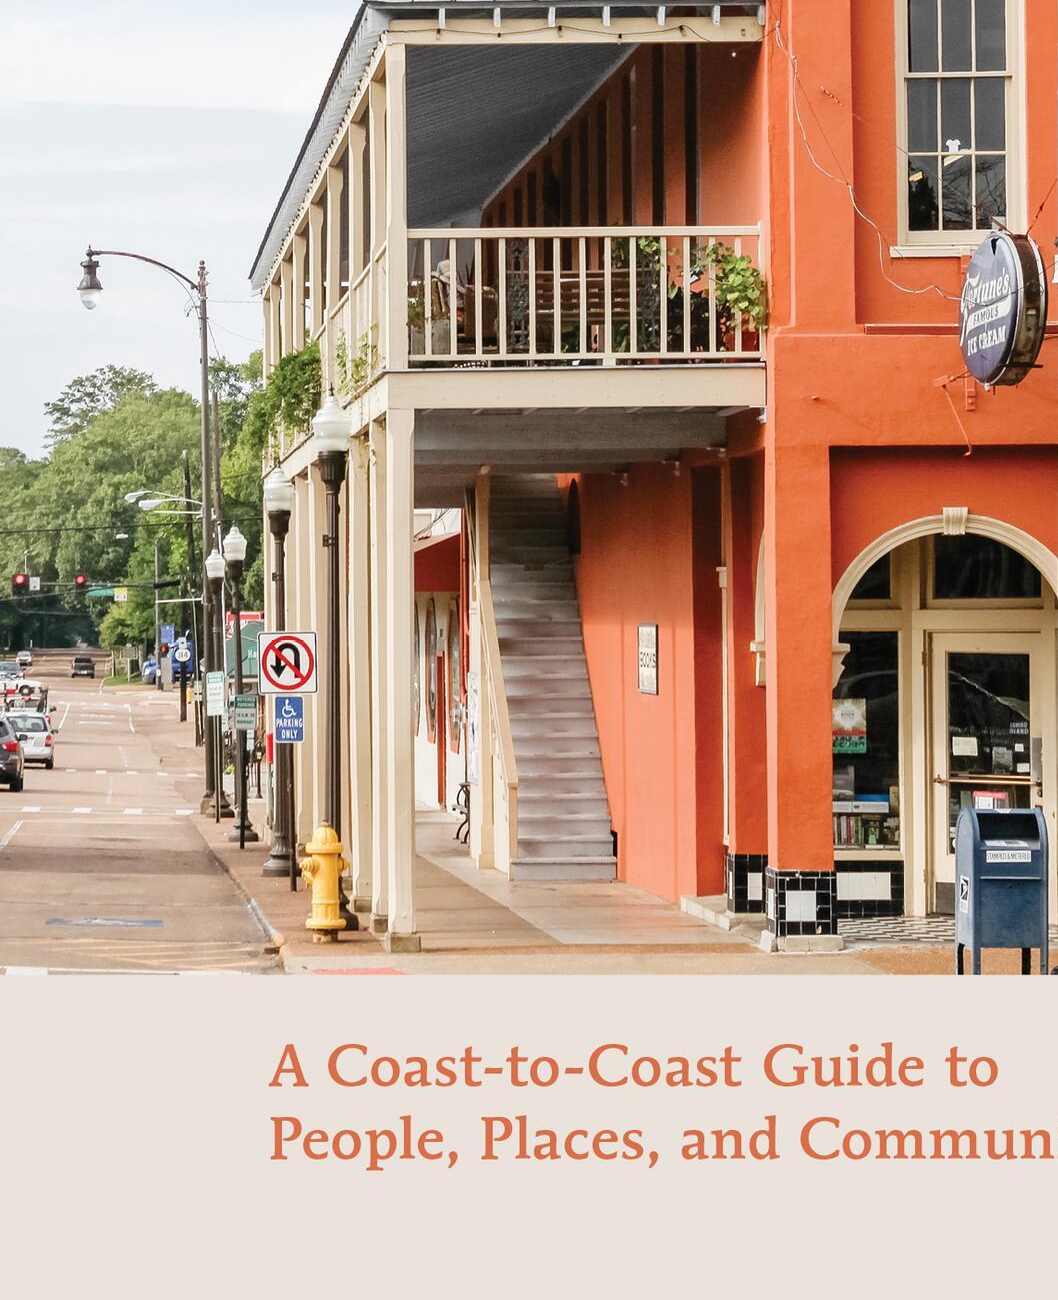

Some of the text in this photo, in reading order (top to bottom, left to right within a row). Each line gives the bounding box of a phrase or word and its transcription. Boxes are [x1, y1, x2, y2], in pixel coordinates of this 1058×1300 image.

[973, 306, 999, 326] FAMOUS
[967, 325, 1007, 356] ICE CREAM
[277, 718, 303, 728] PARKING
[282, 729, 298, 739] ONLY
[987, 852, 1007, 861] STAMPED
[1011, 852, 1030, 861] METERED
